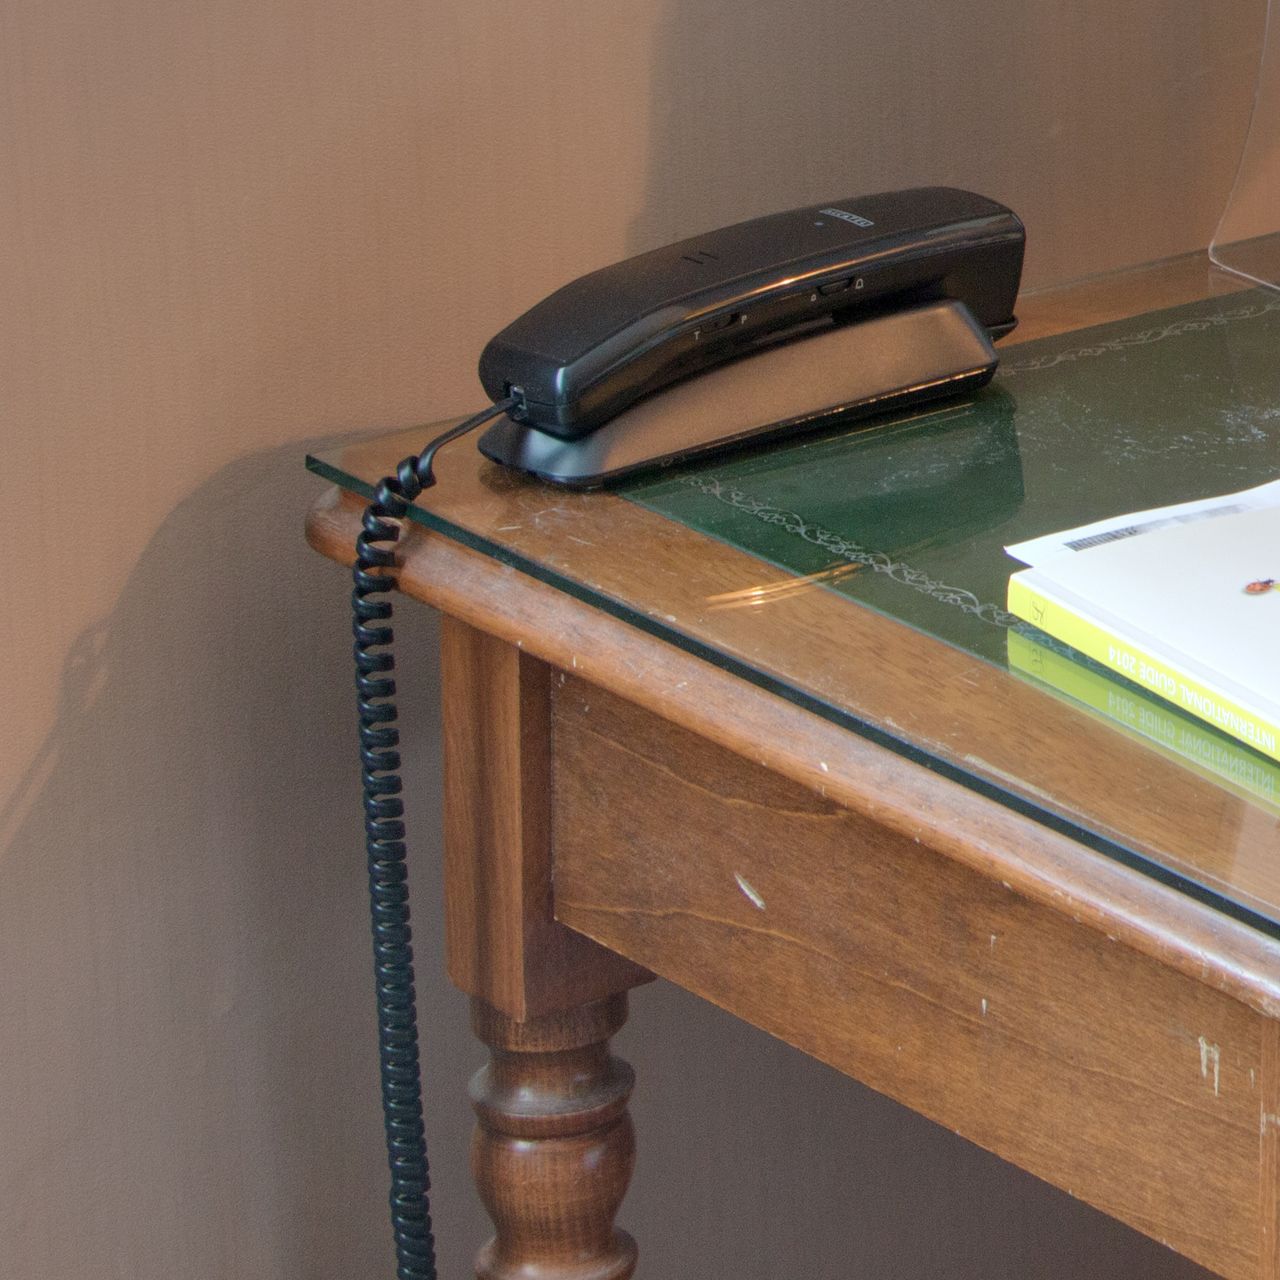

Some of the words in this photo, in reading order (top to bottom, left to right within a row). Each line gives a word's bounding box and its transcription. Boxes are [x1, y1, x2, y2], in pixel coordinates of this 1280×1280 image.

[1108, 645, 1137, 671] 2014
[1139, 660, 1177, 697] GUIDE
[1180, 683, 1275, 753] INTERNATIONAL
